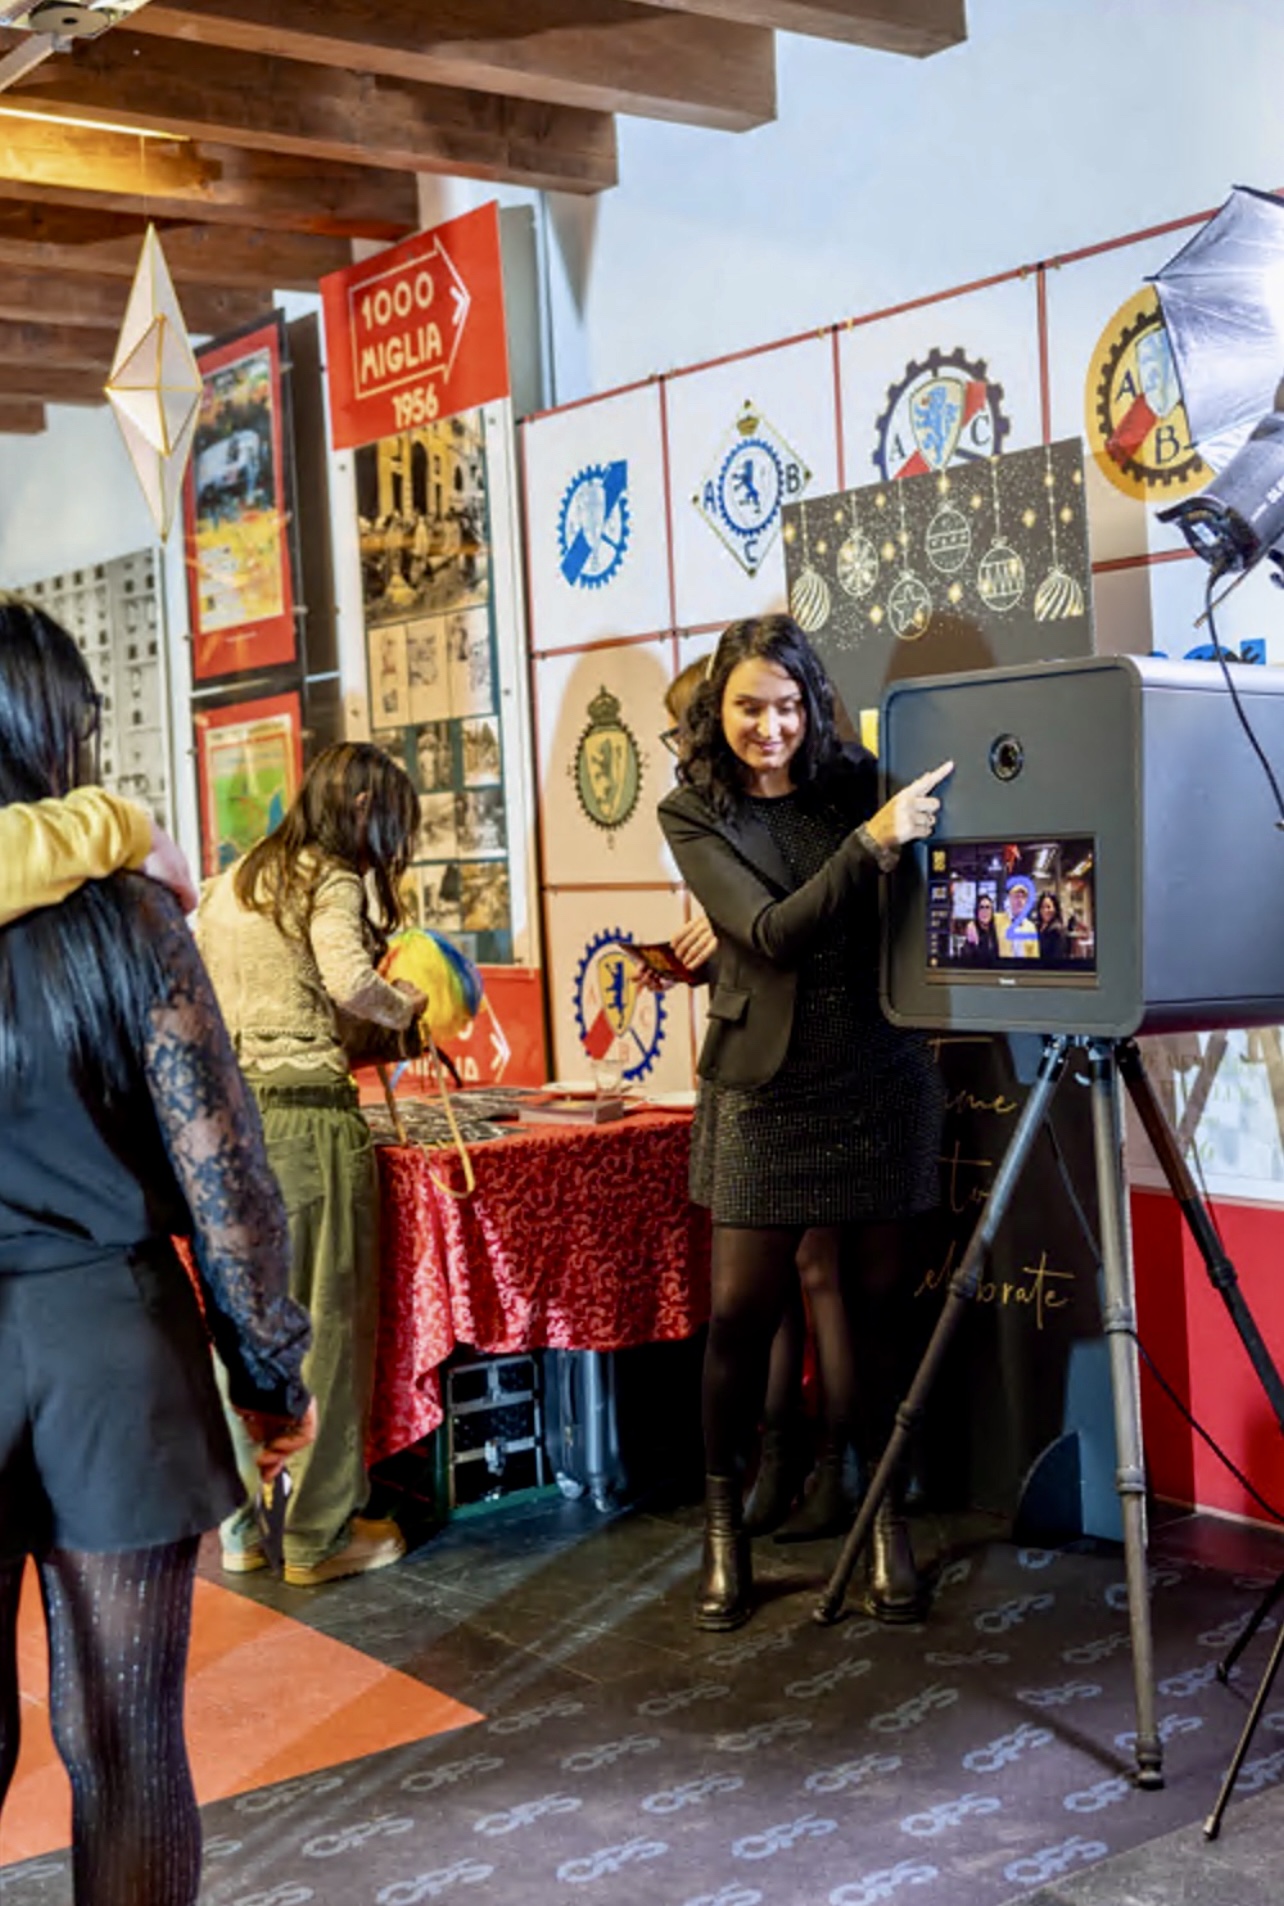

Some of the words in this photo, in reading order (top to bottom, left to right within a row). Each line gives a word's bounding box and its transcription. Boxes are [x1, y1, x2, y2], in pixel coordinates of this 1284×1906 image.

[361, 272, 434, 331] 1000
[361, 322, 442, 384] MIGLIA
[1115, 370, 1138, 403] A
[392, 383, 439, 429] 1956
[971, 415, 990, 446] C
[1155, 425, 1180, 465] B
[889, 433, 905, 462] A
[786, 464, 800, 493] B
[703, 481, 716, 514] A
[744, 540, 758, 563] C
[1005, 875, 1040, 940] 2
